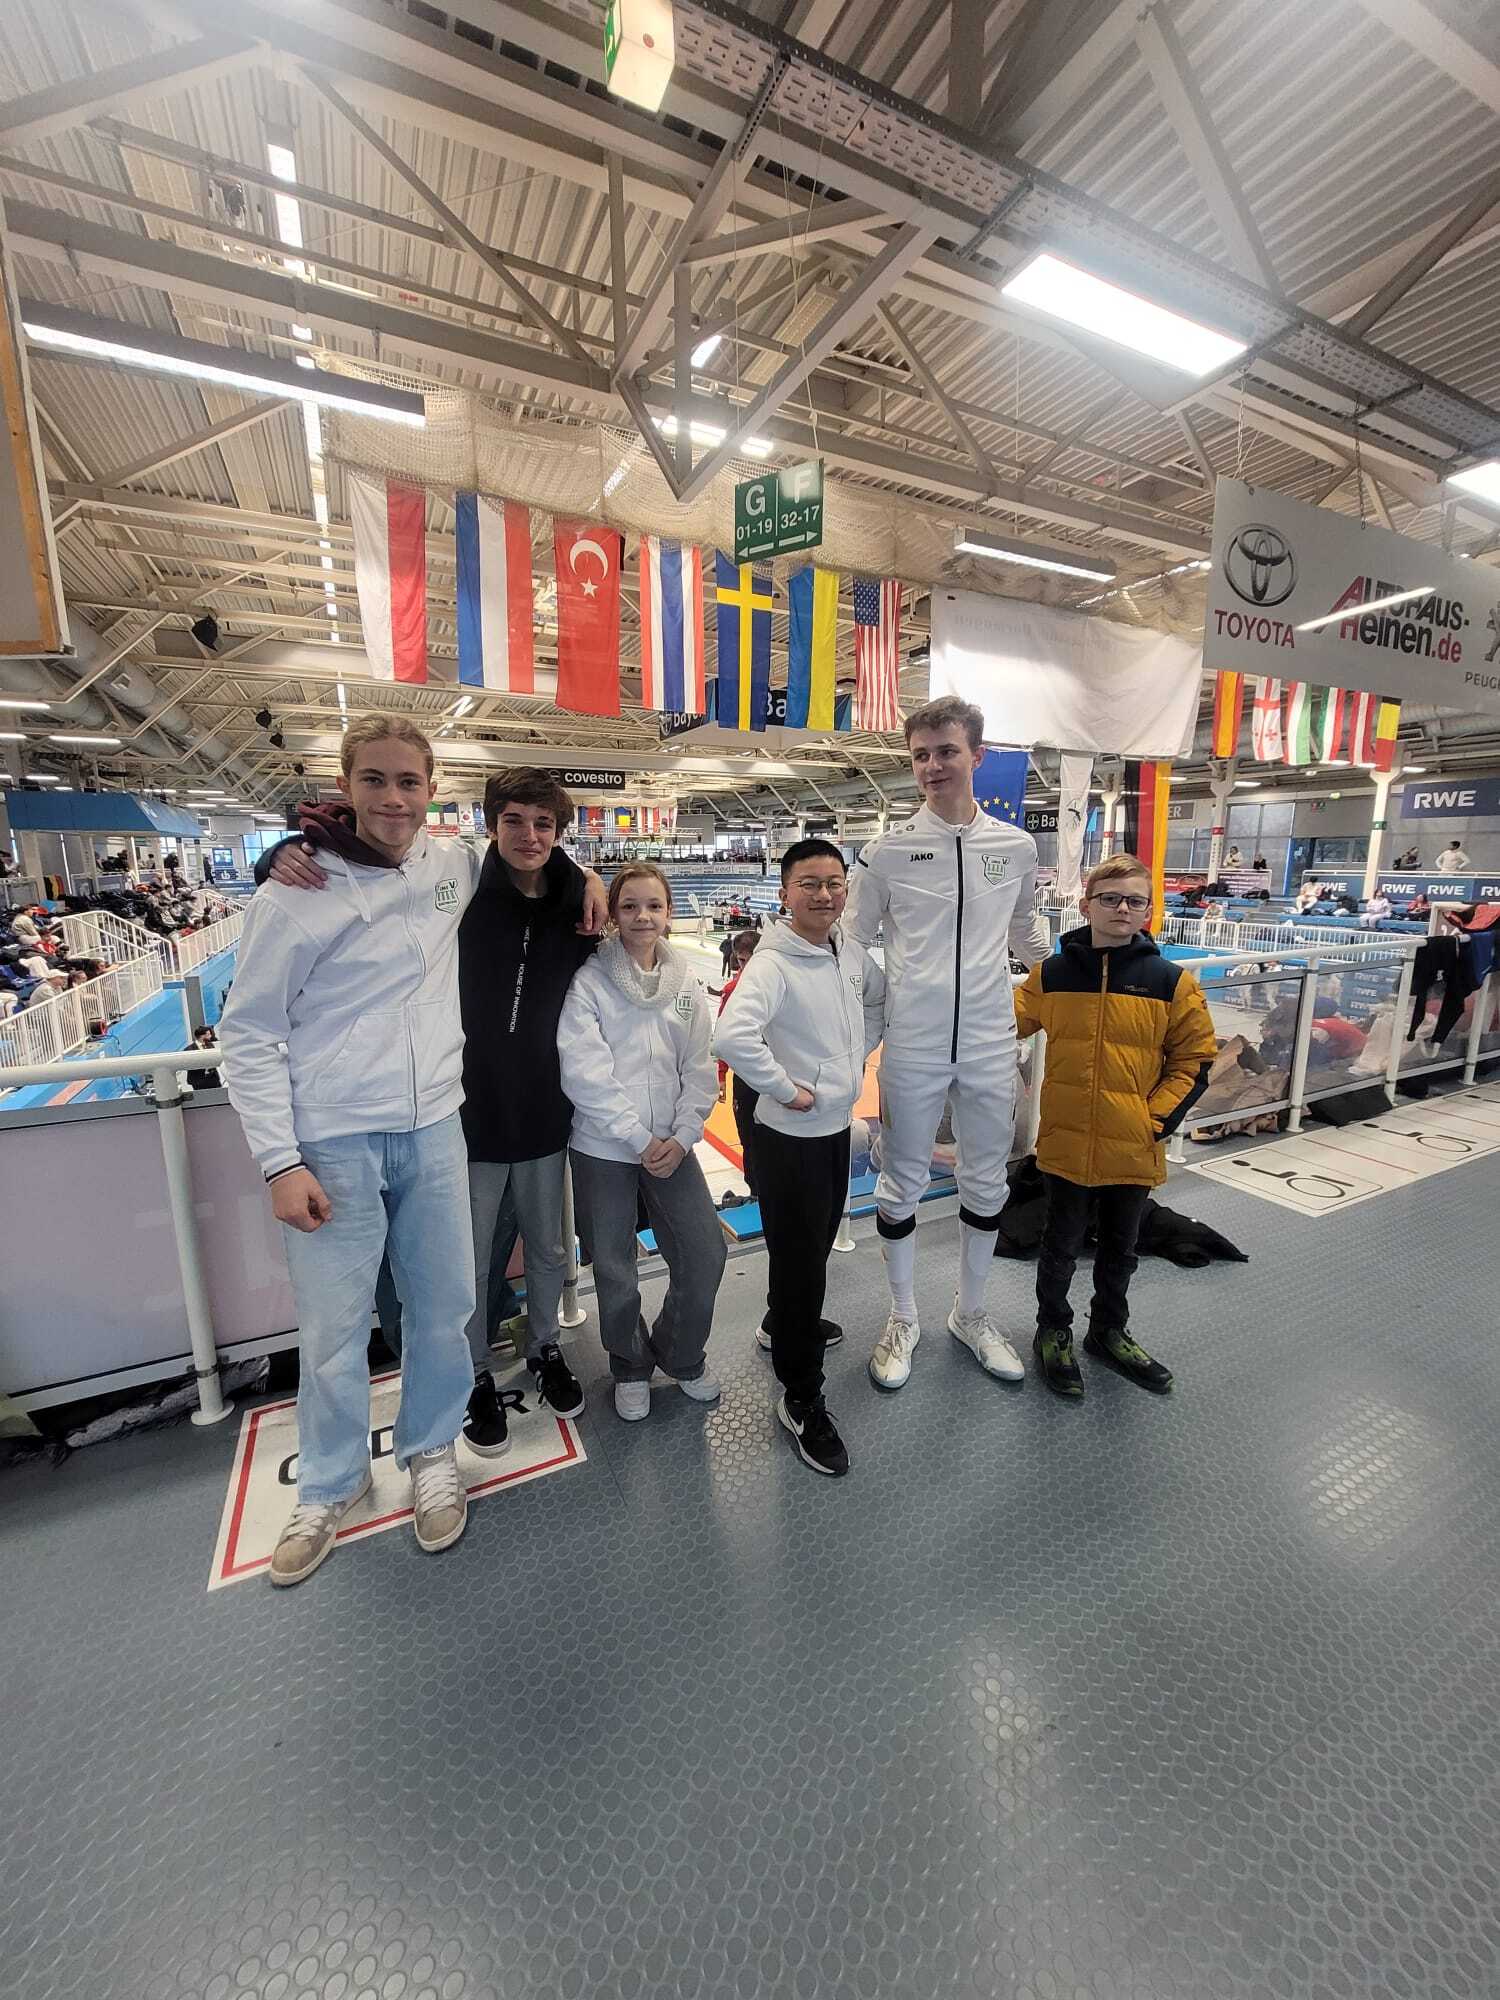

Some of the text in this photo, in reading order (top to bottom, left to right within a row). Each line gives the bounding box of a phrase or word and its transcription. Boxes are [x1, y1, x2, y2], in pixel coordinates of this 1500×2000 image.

[794, 468, 812, 504] F
[745, 484, 766, 516] G
[780, 505, 820, 529] 32-17
[736, 518, 773, 540] 01-19
[1215, 609, 1296, 649] TOYOTA
[1465, 671, 1500, 690] PEUG
[564, 772, 623, 785] covestro
[1413, 789, 1477, 809] RWE
[1041, 815, 1058, 829] Ba
[910, 853, 934, 862] JAKO
[1381, 883, 1417, 894] RWE
[1427, 885, 1466, 896] RWE
